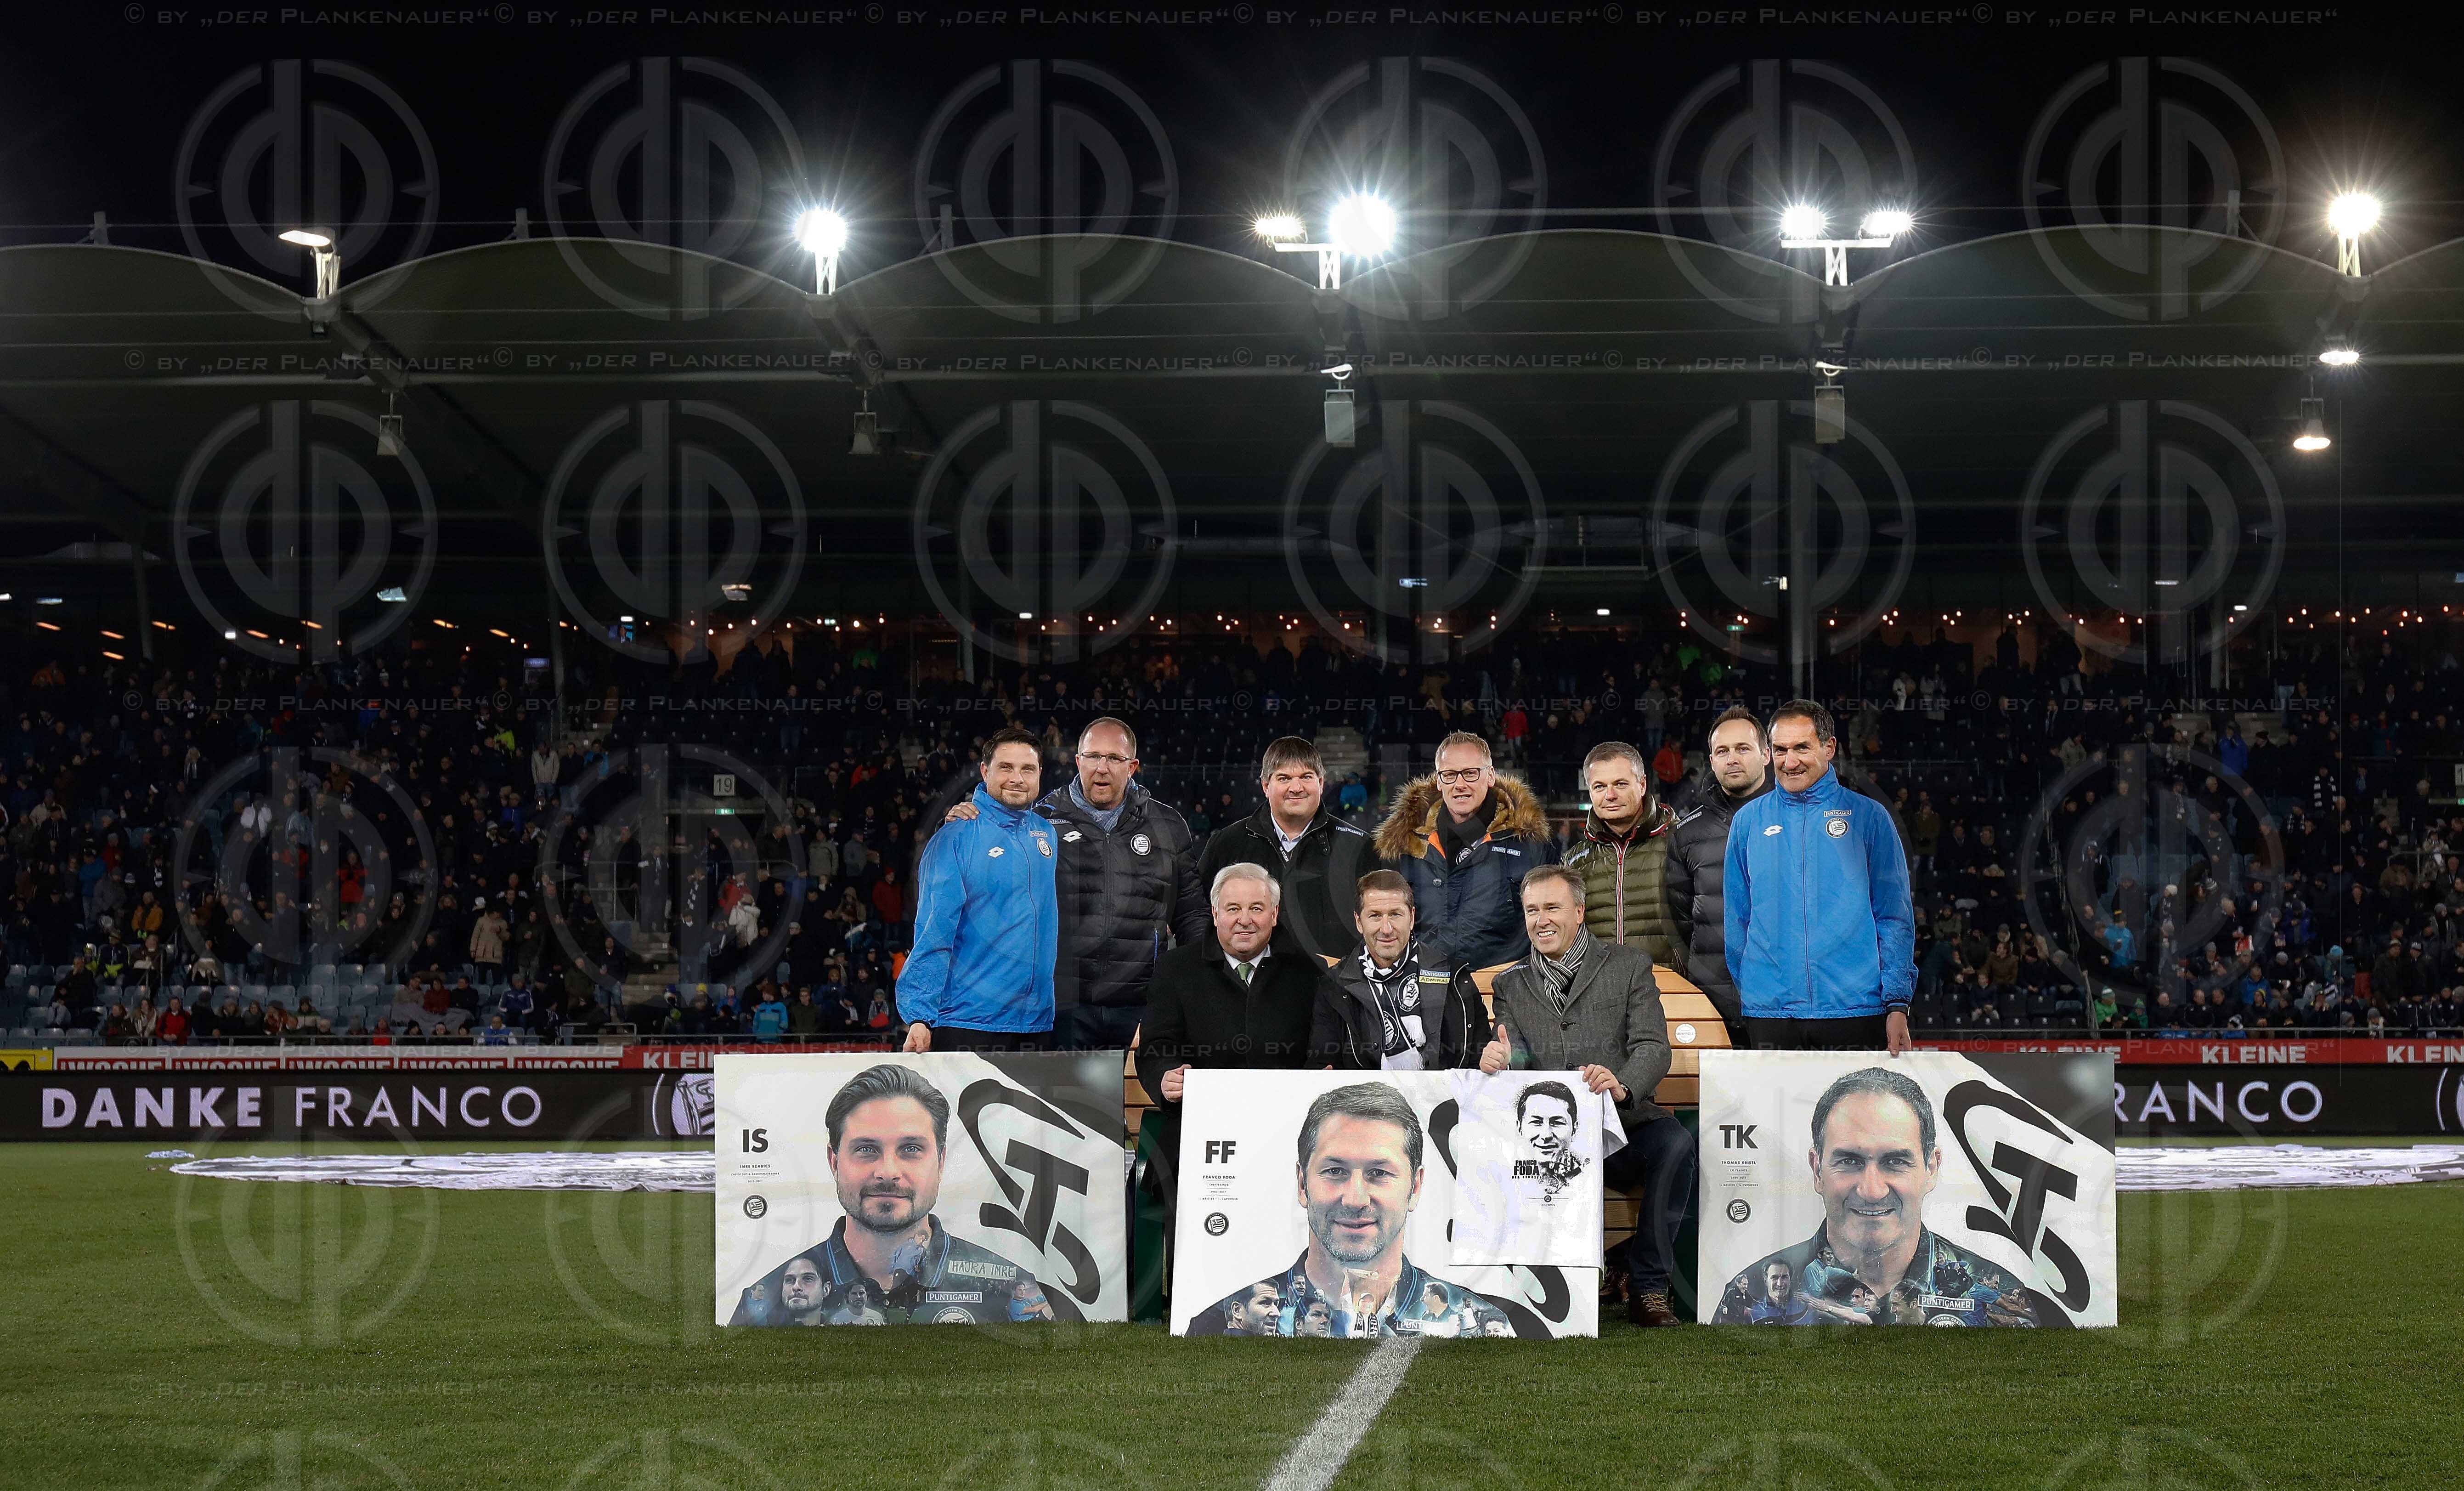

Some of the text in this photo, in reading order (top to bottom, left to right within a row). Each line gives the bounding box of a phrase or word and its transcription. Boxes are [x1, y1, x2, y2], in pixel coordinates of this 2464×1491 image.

[716, 777, 732, 793] 19
[2202, 1045, 2306, 1064] KLEINE
[42, 1086, 543, 1128] DANKE FRANCO
[742, 1128, 769, 1153] IS
[1719, 1125, 1758, 1149] TK
[1205, 1140, 1236, 1164] FF
[1514, 1165, 1540, 1176] FODA
[952, 1260, 1016, 1277] HAJRA IMRE
[1921, 1297, 1971, 1309] PUNTIGAMER
